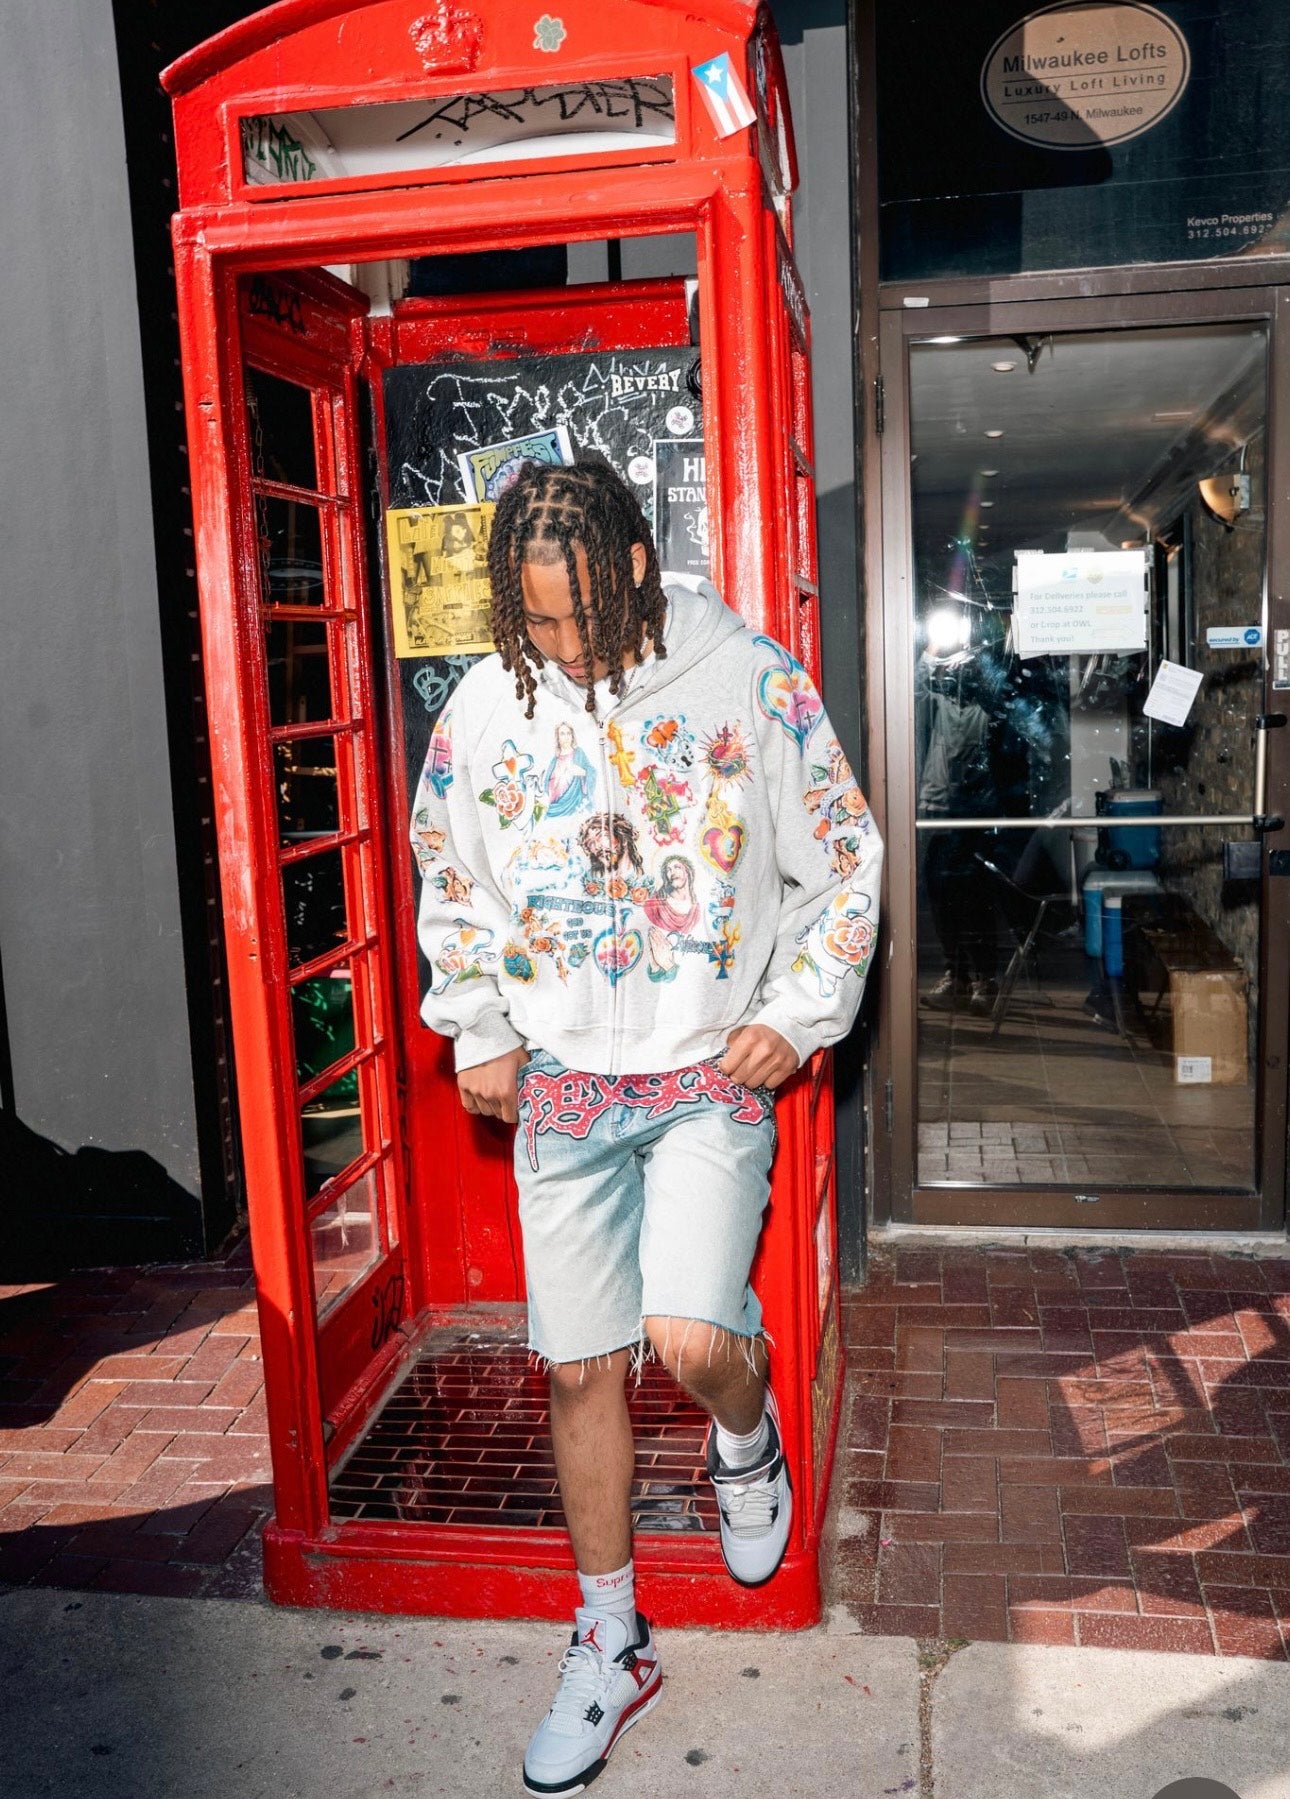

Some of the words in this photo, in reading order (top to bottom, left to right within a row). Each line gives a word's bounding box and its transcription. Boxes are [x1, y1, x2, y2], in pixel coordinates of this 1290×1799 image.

[1003, 50, 1108, 73] Milwaukee
[1117, 42, 1167, 62] Lofts
[1004, 83, 1061, 98] Luxury
[1070, 78, 1104, 91] Loft
[1113, 73, 1165, 87] Living
[1025, 110, 1068, 125] 1547-49
[1086, 105, 1144, 120] Milwaukee
[1187, 217, 1219, 227] Kevco
[1221, 212, 1274, 224] Properties
[1030, 592, 1042, 600] For
[1044, 591, 1084, 600] Deliveries
[1086, 591, 1113, 601] please
[1114, 589, 1128, 598] call
[1063, 620, 1071, 628] at
[1072, 619, 1092, 628] OWL
[1030, 635, 1054, 643] Thank
[1057, 635, 1074, 644] you!
[527, 895, 616, 917] RIGHTEOUS
